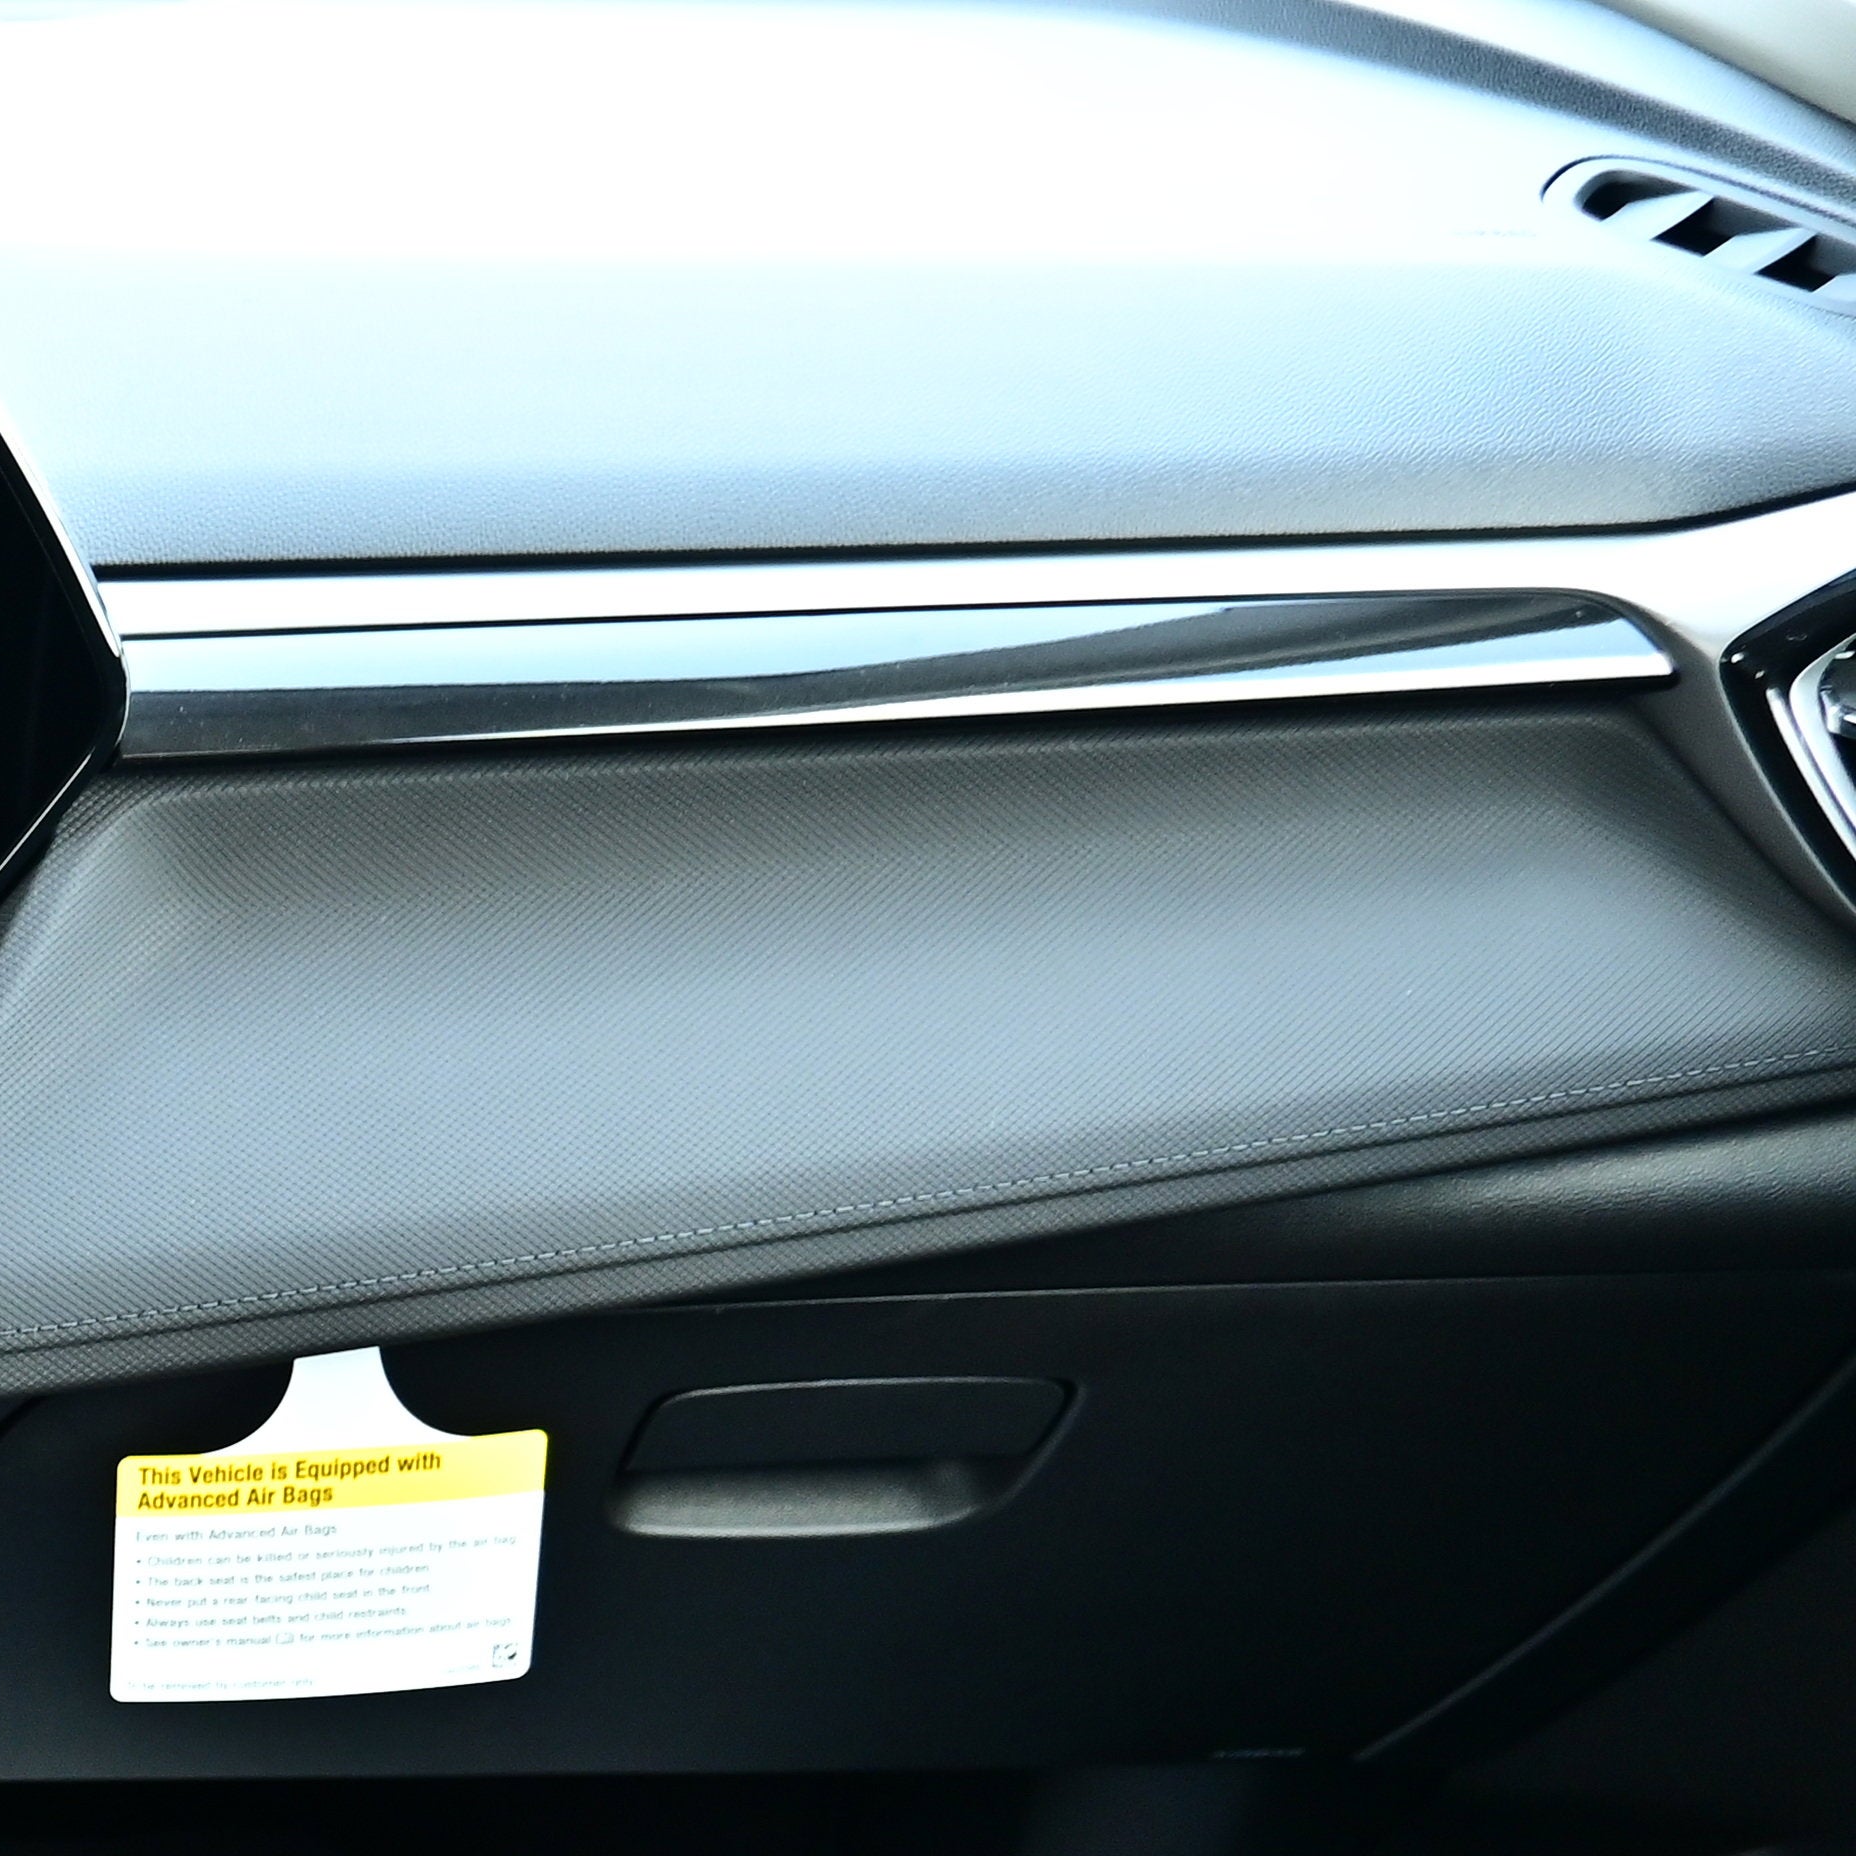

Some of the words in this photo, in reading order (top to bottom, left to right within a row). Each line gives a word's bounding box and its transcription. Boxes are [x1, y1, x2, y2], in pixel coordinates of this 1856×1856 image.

[139, 1467, 181, 1485] This
[189, 1463, 263, 1484] Vehicle
[271, 1463, 287, 1480] is
[295, 1456, 390, 1481] Equipped
[397, 1453, 441, 1472] with
[138, 1489, 239, 1510] Advanced
[247, 1487, 274, 1505] Air
[283, 1486, 333, 1507] Bags
